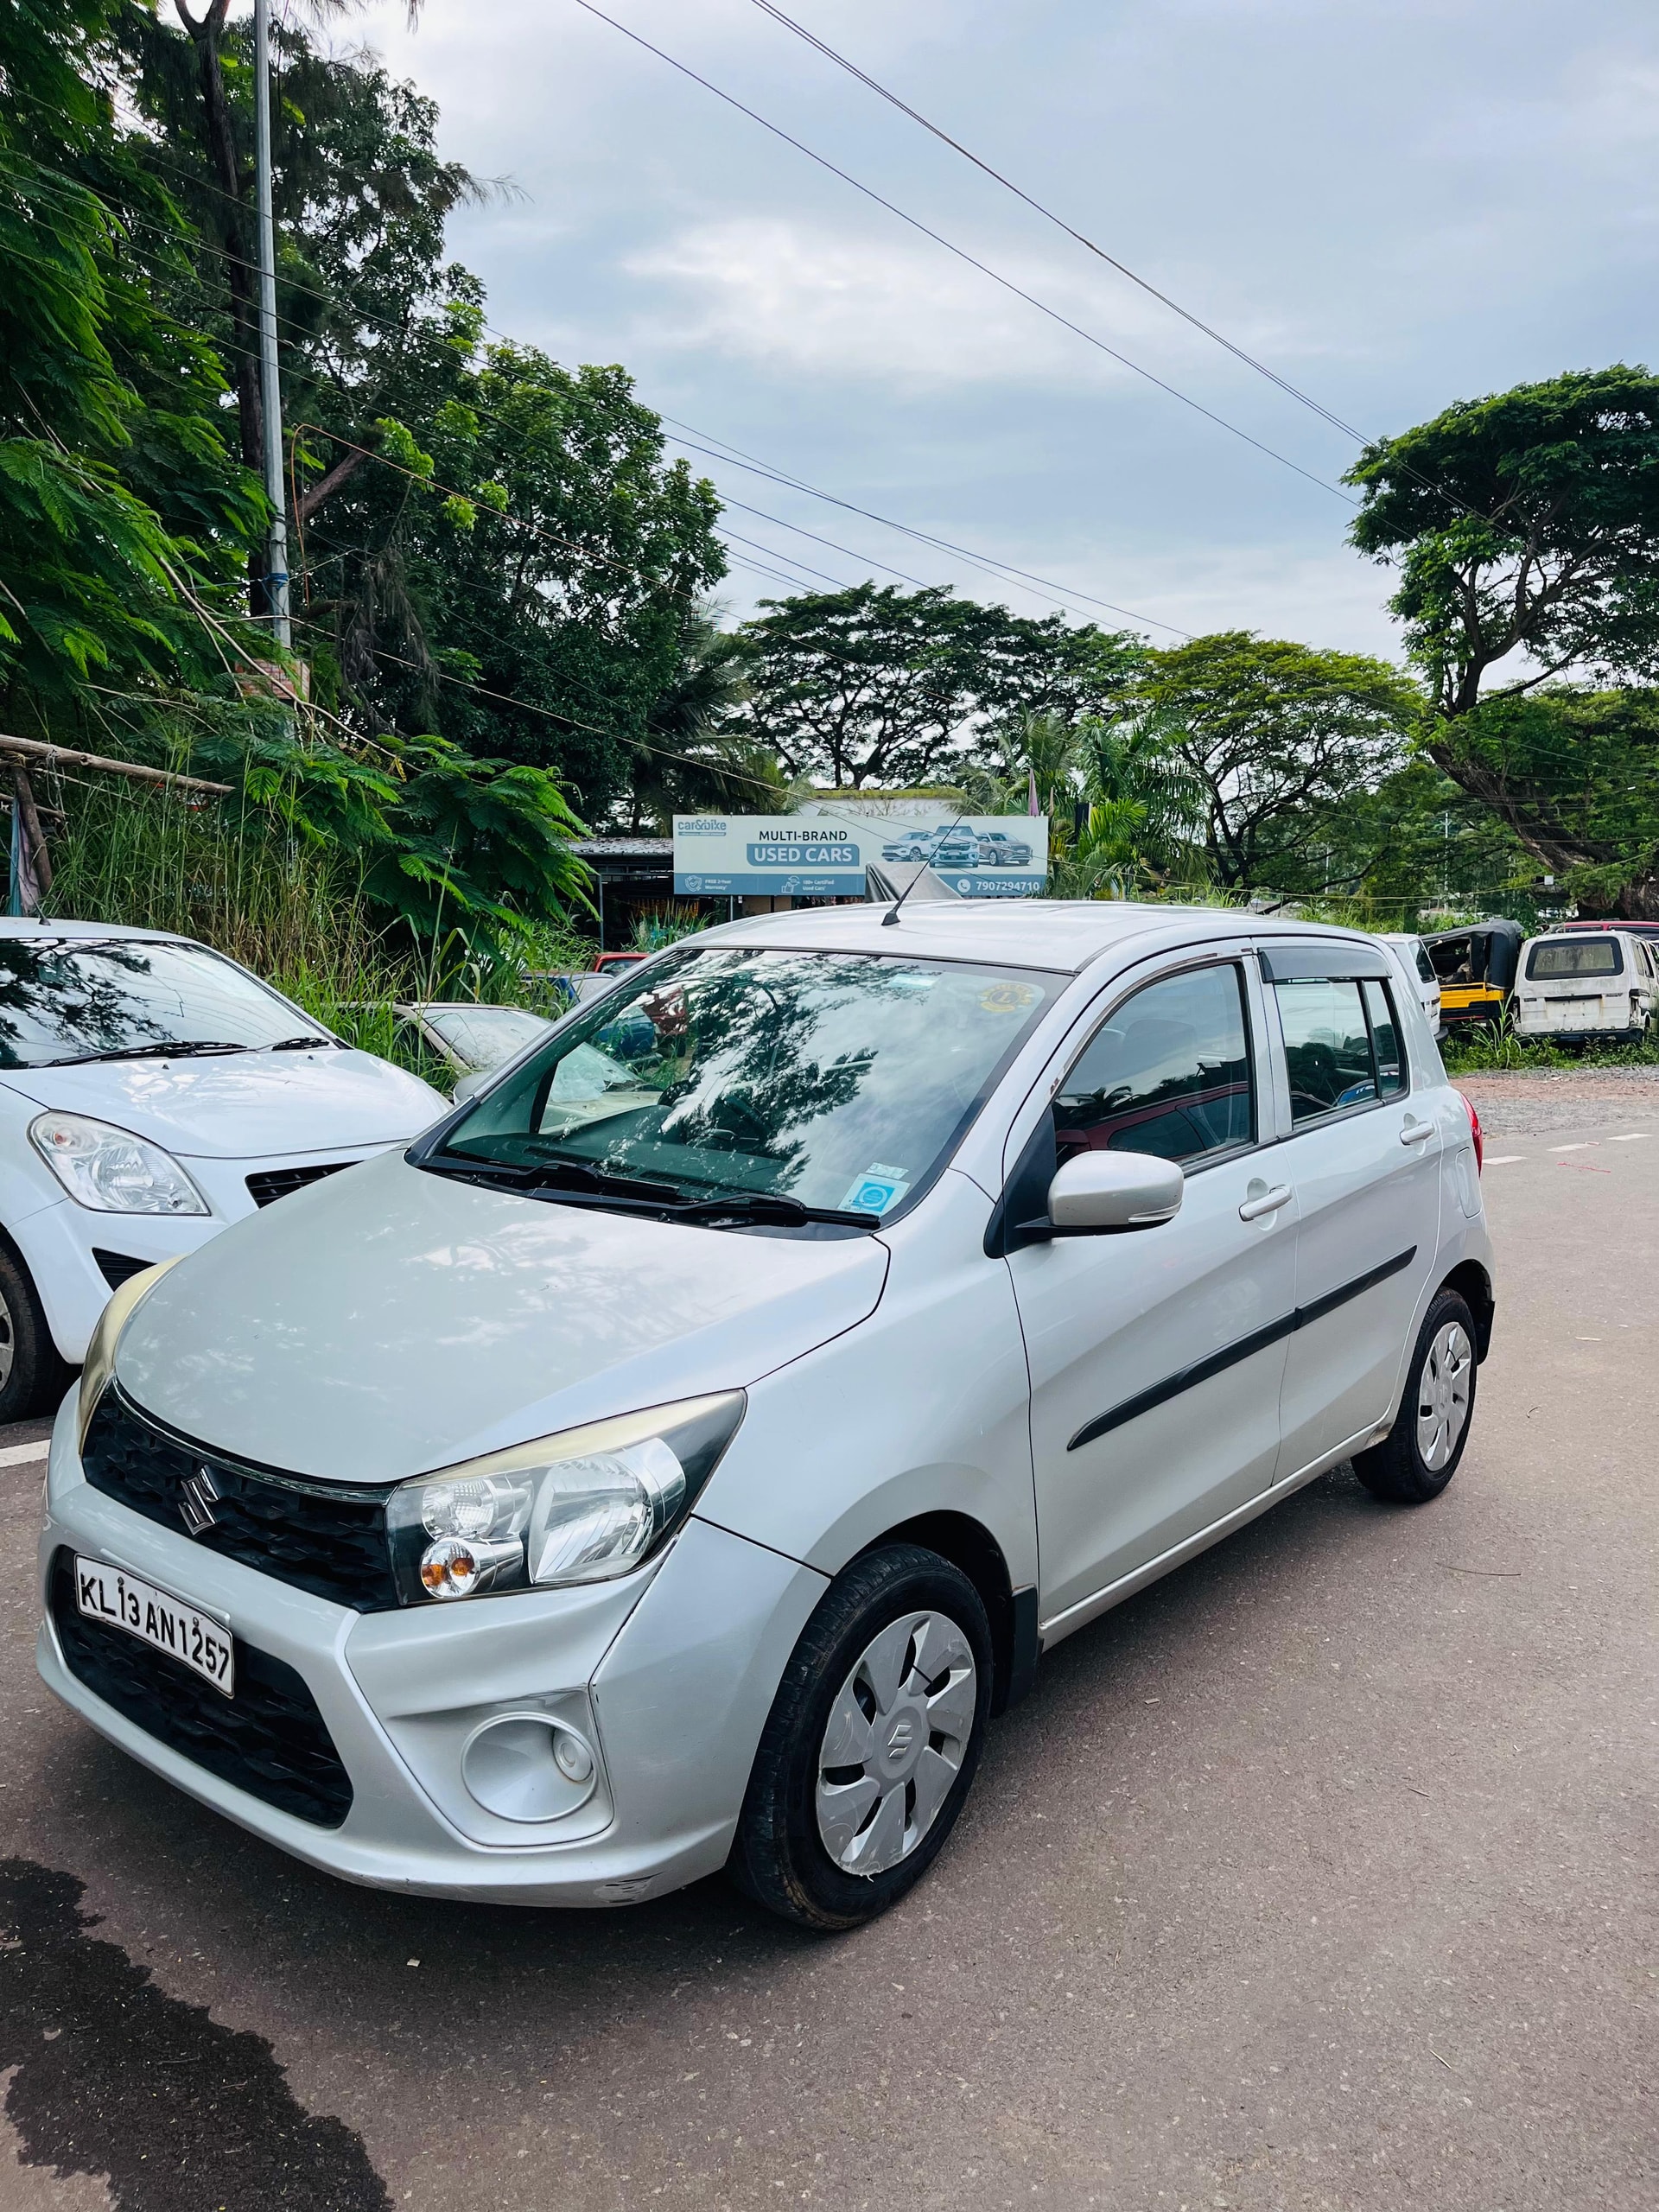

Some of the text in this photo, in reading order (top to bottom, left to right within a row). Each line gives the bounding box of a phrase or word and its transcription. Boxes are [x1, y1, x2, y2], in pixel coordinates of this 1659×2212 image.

[678, 819, 727, 830] car&bike
[759, 830, 848, 842] MULTI-BRAND
[754, 848, 853, 862] USED CARS
[976, 881, 1040, 892] 7907294710
